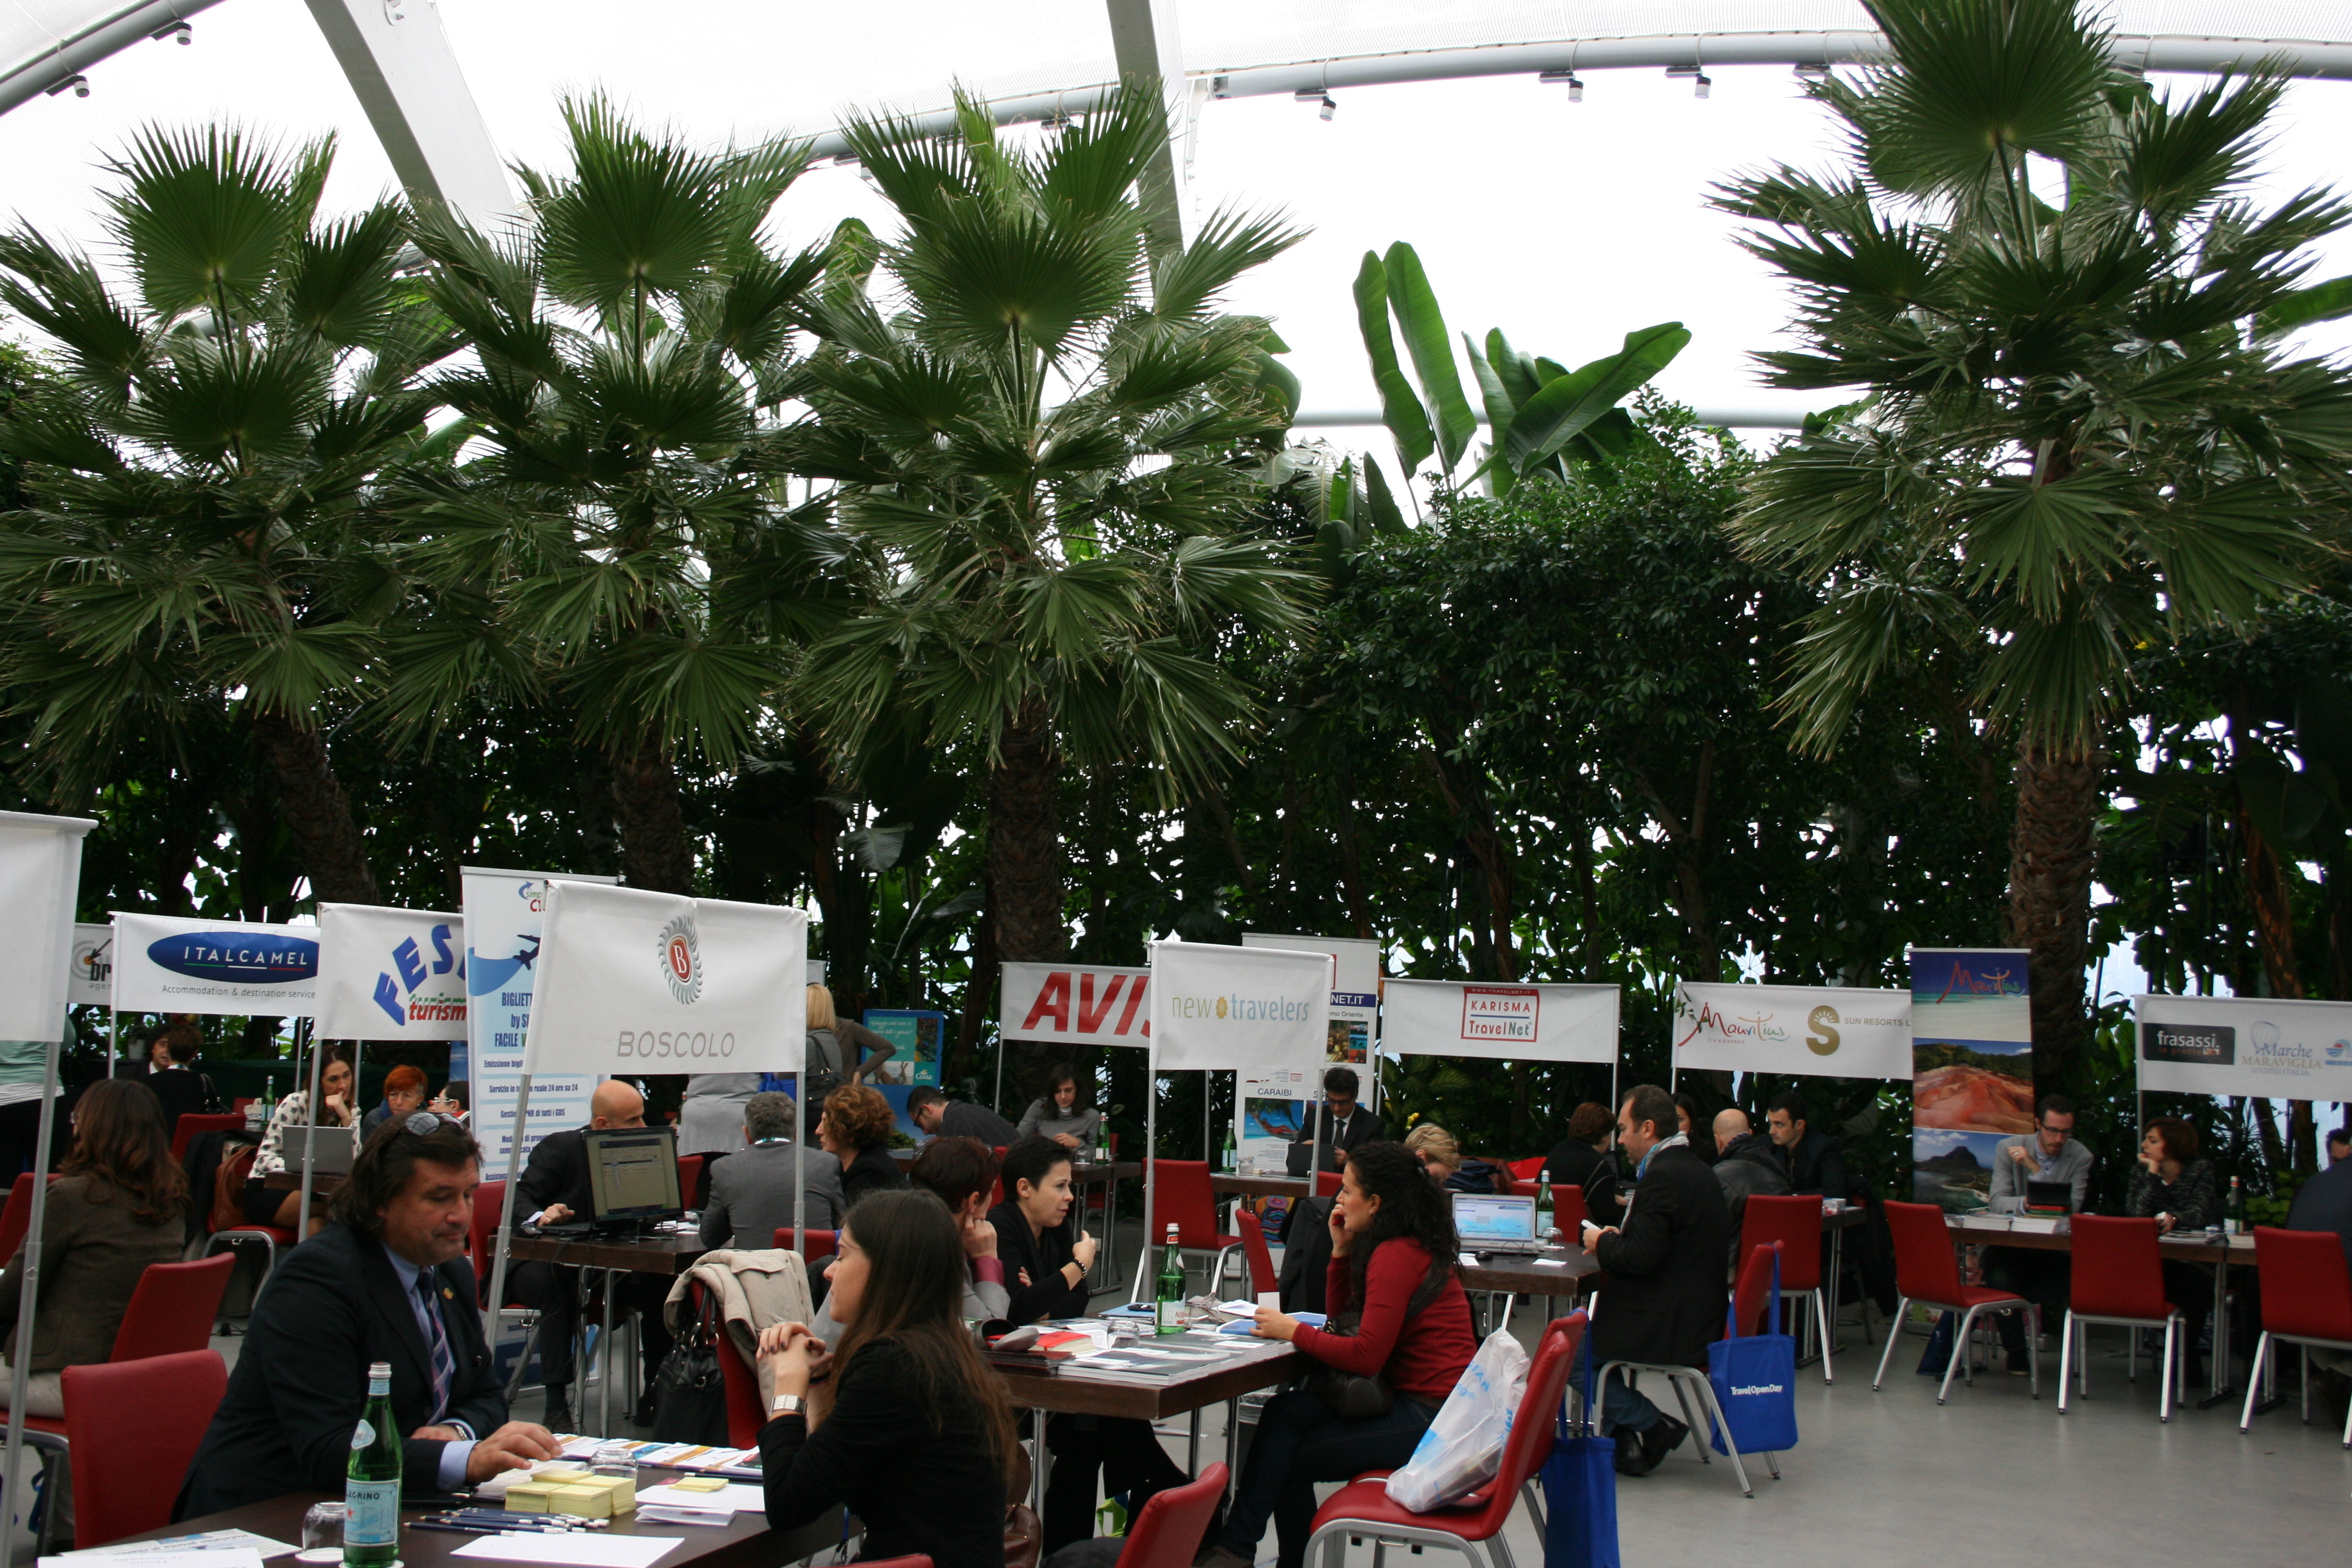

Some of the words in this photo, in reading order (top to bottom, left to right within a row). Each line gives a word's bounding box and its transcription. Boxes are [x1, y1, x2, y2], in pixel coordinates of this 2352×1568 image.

[184, 946, 307, 965] ITALCAMEL
[672, 944, 687, 973] B
[373, 924, 466, 1027] FES
[162, 985, 228, 996] Accommodation
[232, 987, 238, 996] &
[241, 988, 286, 998] destination
[1021, 972, 1151, 1039] AVI
[1331, 994, 1364, 1005] NET.IT
[1471, 1001, 1530, 1013] KARISMA
[1172, 997, 1212, 1019] new
[1231, 993, 1310, 1022] travelers
[511, 1014, 520, 1029] by
[1678, 1001, 1791, 1047] Mauritius
[1864, 1018, 1903, 1027] RESORTS
[495, 1033, 518, 1047] FACILE
[617, 1031, 735, 1058] BOSCOLO
[2255, 1043, 2313, 1058] Marche
[2241, 1056, 2322, 1069] MARAVIGLIA
[1258, 1088, 1292, 1097] CARAIBI
